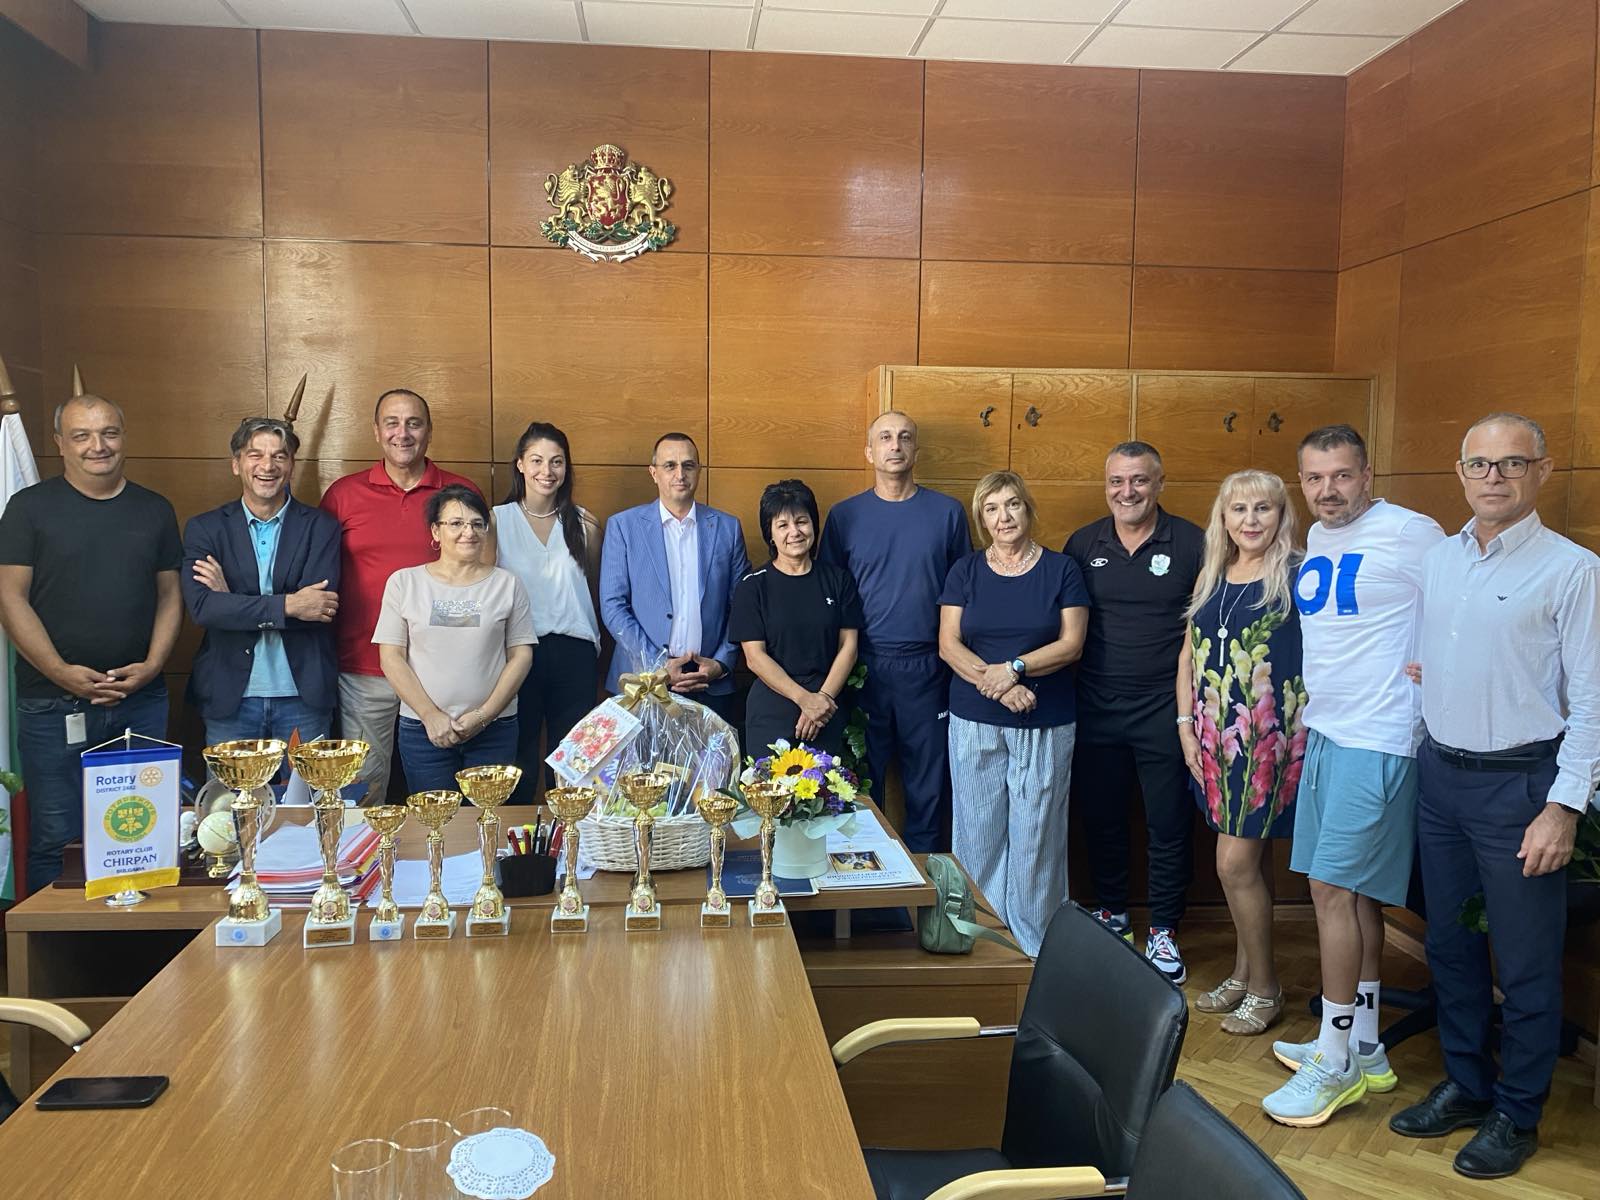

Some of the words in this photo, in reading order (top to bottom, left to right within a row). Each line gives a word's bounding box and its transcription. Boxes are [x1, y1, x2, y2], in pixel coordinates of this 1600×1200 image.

[96, 775, 136, 786] Rotary
[96, 786, 121, 794] DISTRICT
[106, 848, 134, 856] ROTARY
[103, 853, 157, 868] CHIRPAN
